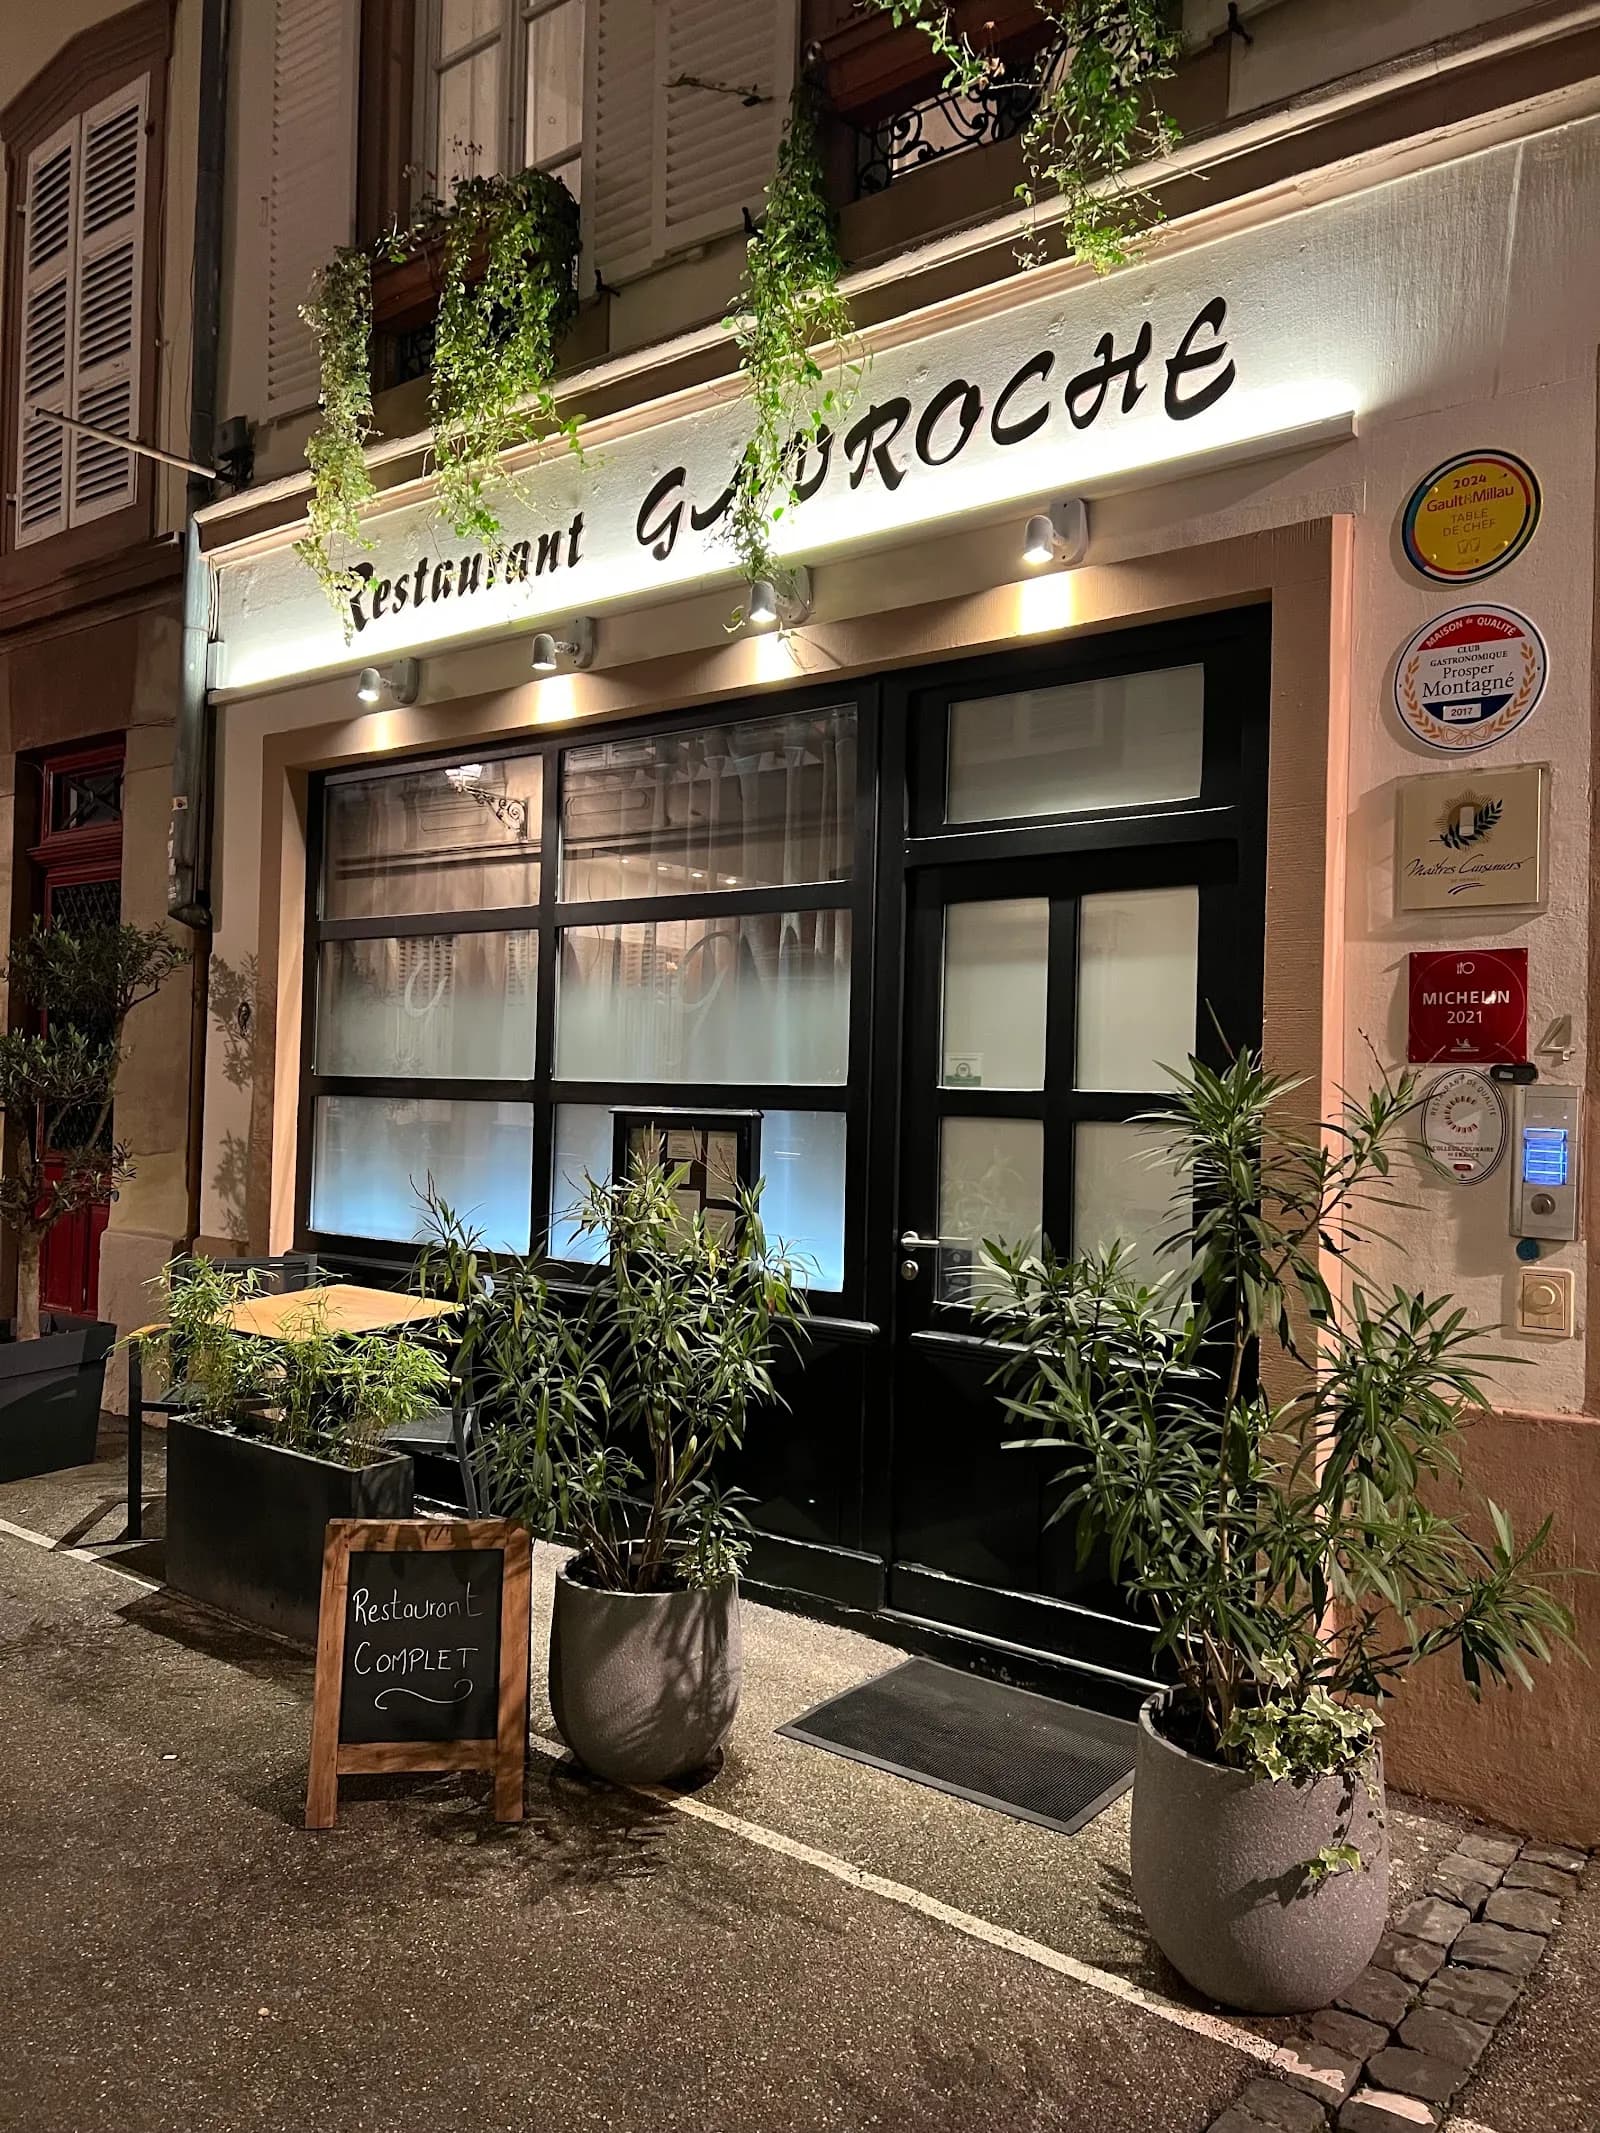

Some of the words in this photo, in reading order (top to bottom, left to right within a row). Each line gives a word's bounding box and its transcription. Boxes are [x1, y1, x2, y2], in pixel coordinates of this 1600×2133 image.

[1453, 474, 1487, 490] 2024
[1451, 508, 1489, 525] TABLE
[1443, 526, 1459, 537] DE
[1463, 518, 1496, 533] CHEF
[1426, 619, 1464, 648] MAISON
[1477, 616, 1518, 637] QUALITÉ
[1457, 644, 1480, 654] CLUB
[1430, 650, 1509, 668] GASTRONOMIQUE
[1443, 664, 1495, 680] Prosper
[1422, 672, 1515, 698] Montagné
[1451, 707, 1473, 717] 2017
[1459, 853, 1535, 874] Cuisiniers
[1423, 990, 1510, 1006] MICHELIN
[1447, 1010, 1483, 1024] 2021
[1430, 1079, 1464, 1117] RESTRANT
[352, 1581, 484, 1626] Restaurant
[354, 1641, 479, 1675] COMPLET
